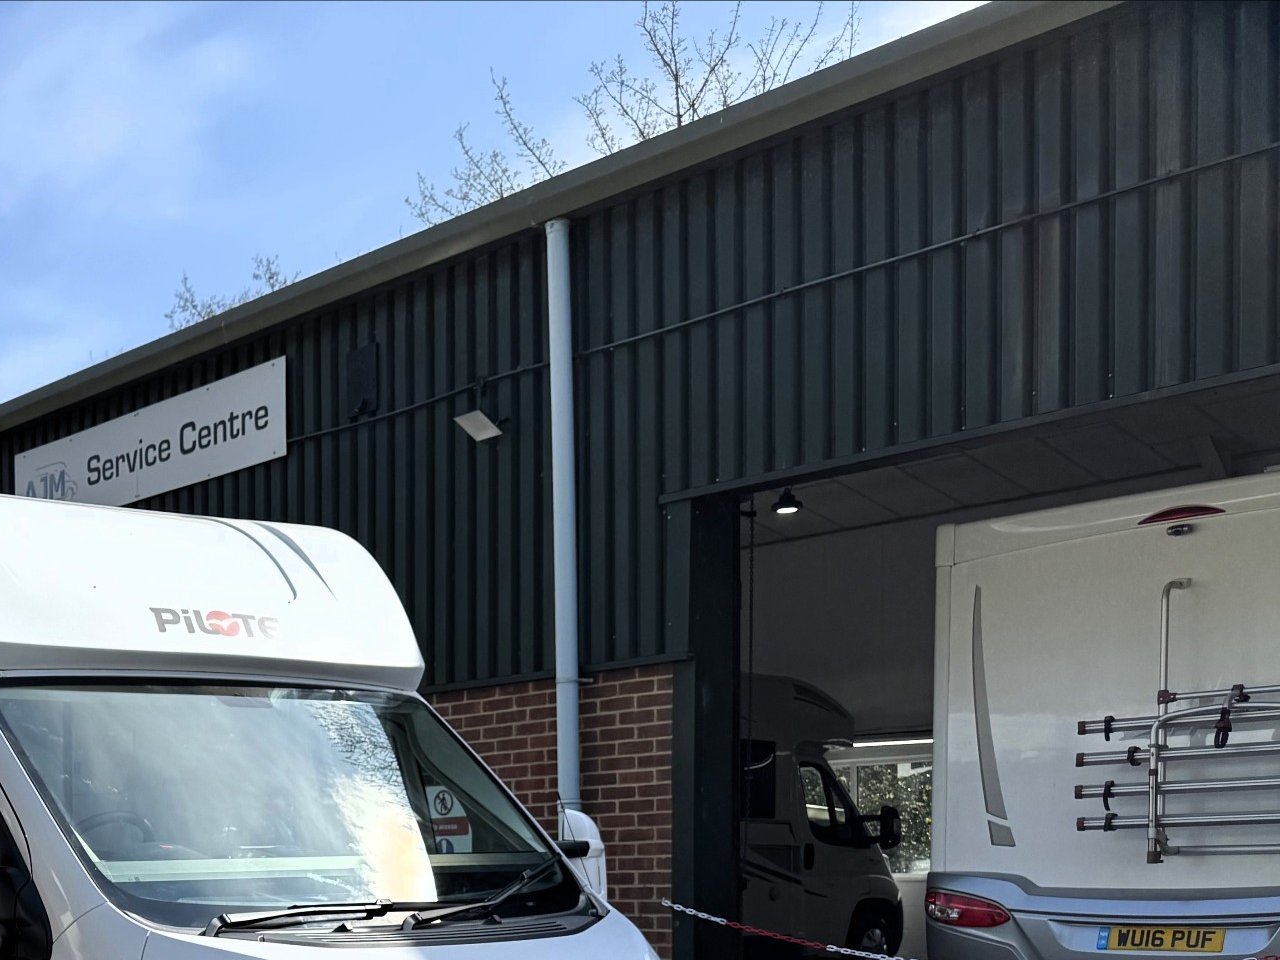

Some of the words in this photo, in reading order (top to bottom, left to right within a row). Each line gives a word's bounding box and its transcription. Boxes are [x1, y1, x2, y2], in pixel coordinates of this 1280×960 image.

[86, 439, 171, 486] Service
[179, 404, 270, 455] Centre
[1117, 929, 1165, 948] WU16
[1170, 929, 1217, 949] PUF
